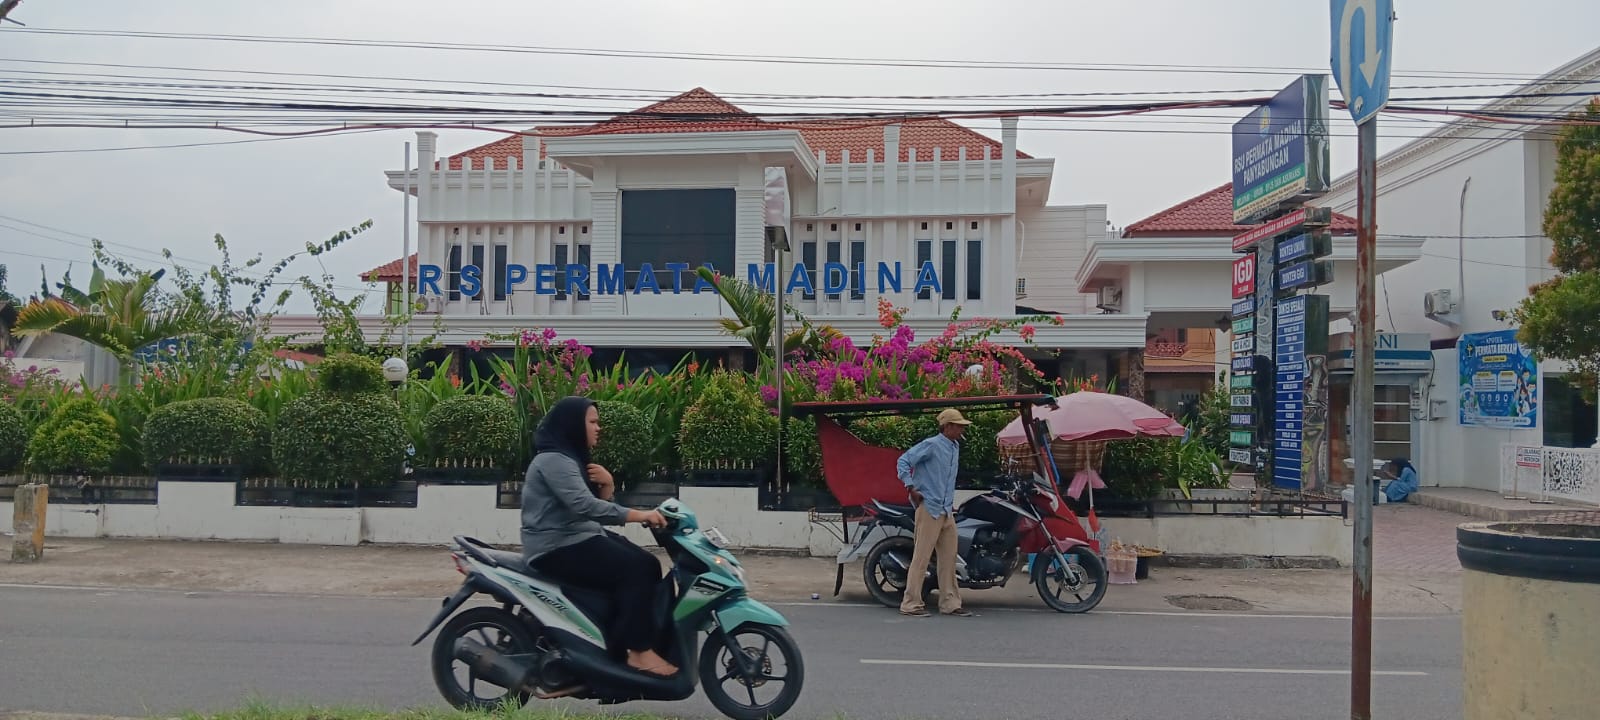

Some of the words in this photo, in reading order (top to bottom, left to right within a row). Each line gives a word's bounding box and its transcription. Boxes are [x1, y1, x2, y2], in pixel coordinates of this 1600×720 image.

[1246, 139, 1273, 166] PERMATA
[1274, 119, 1302, 150] MADINA
[1243, 146, 1289, 186] PANYABUNGAN
[505, 262, 721, 296] PERMATA
[747, 260, 942, 296] MADINA
[1234, 258, 1253, 286] IGD
[1375, 334, 1398, 349] NI
[1475, 343, 1497, 357] PERMATA
[1497, 342, 1518, 355] BERKAH
